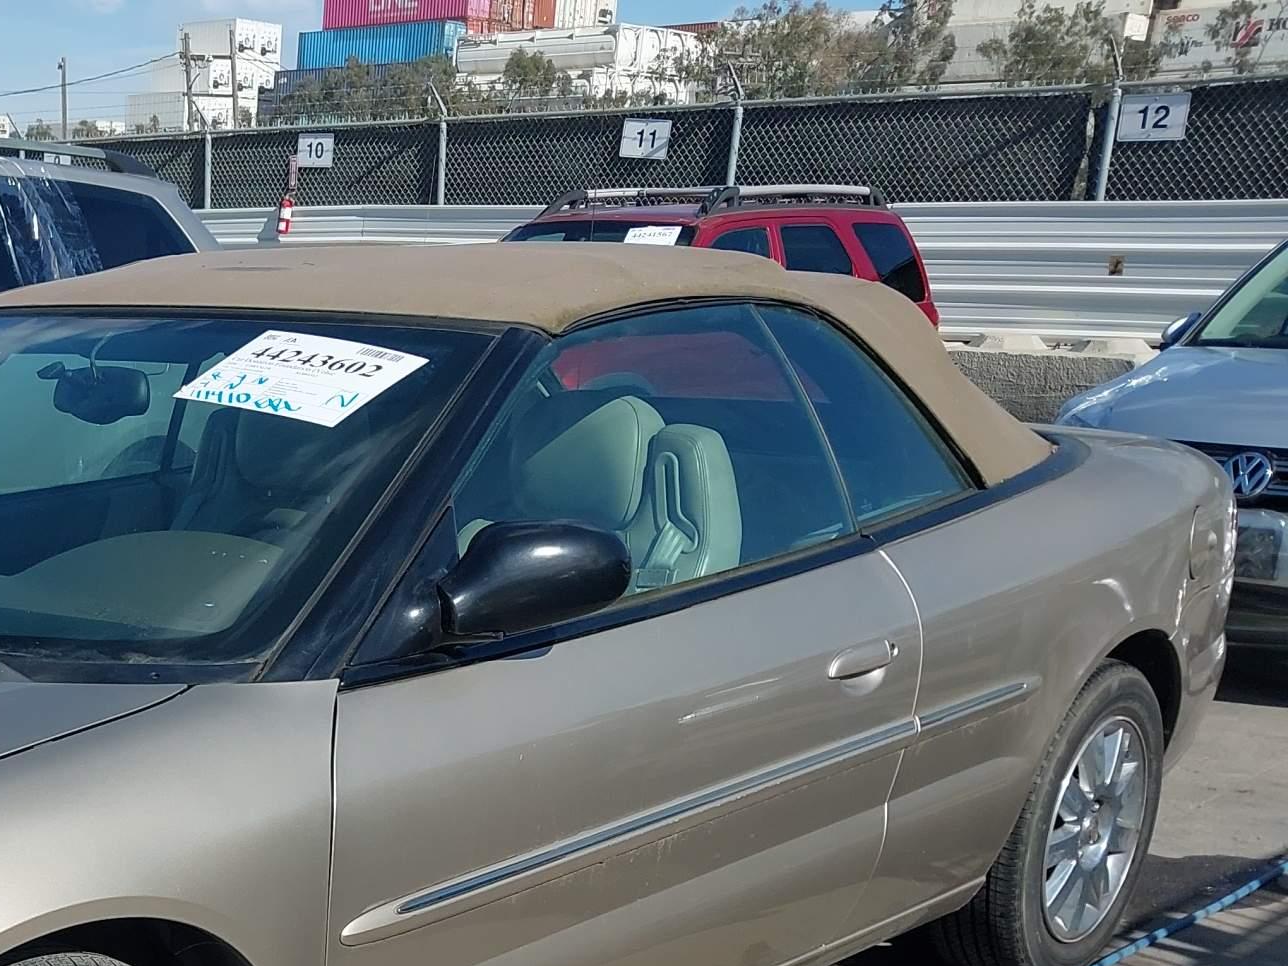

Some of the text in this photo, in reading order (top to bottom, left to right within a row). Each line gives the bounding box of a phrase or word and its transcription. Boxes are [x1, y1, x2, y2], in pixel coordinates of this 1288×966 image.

[1138, 105, 1170, 129] 12
[637, 129, 657, 148] 11
[307, 142, 324, 159] 10
[251, 346, 384, 378] 44243602
